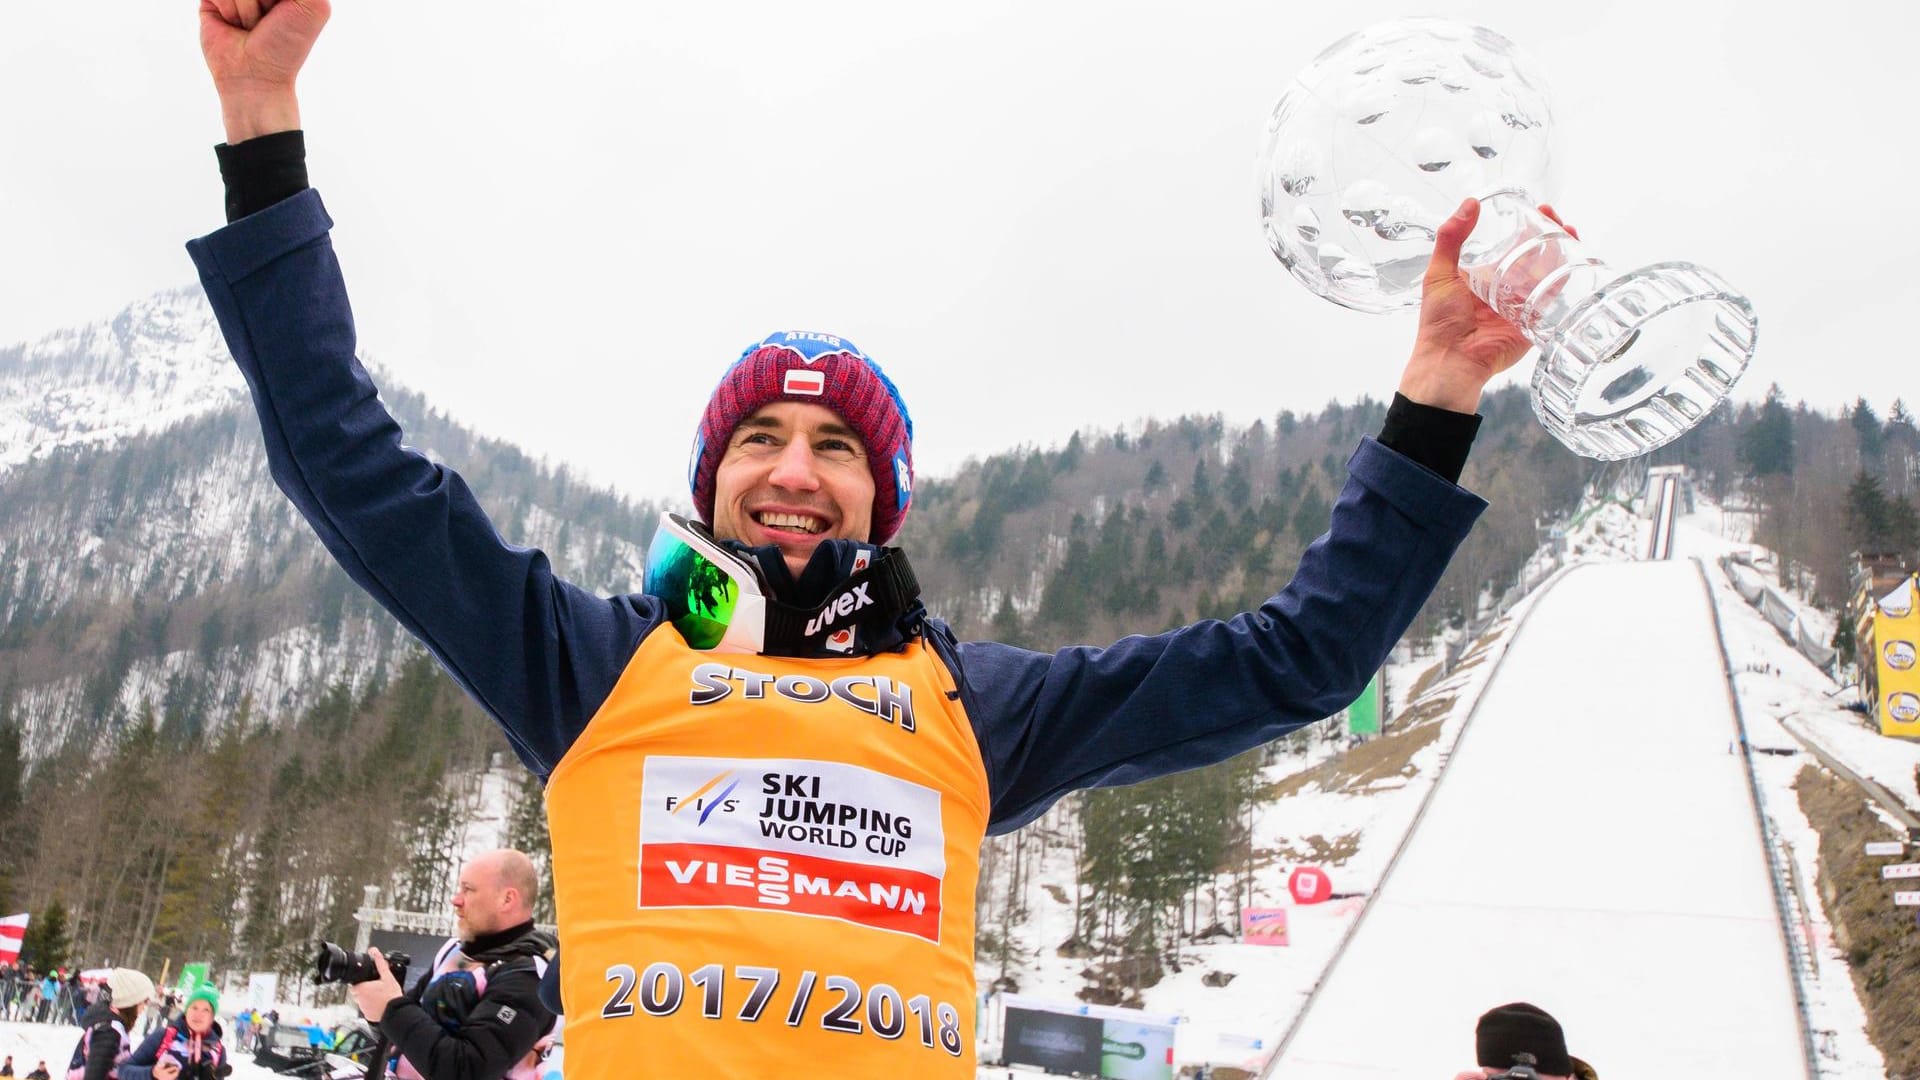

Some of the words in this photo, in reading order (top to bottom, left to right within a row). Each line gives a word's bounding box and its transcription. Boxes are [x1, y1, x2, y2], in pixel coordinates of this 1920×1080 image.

[784, 331, 840, 347] ATLAS
[804, 581, 875, 637] uvex
[690, 663, 916, 732] STOCH
[762, 773, 821, 799] SKI
[758, 820, 857, 849] WORLD
[865, 834, 906, 858] CUP
[759, 797, 912, 839] JUMPING
[665, 856, 925, 915] VIESSMANN
[601, 962, 962, 1056] 2017/2018
